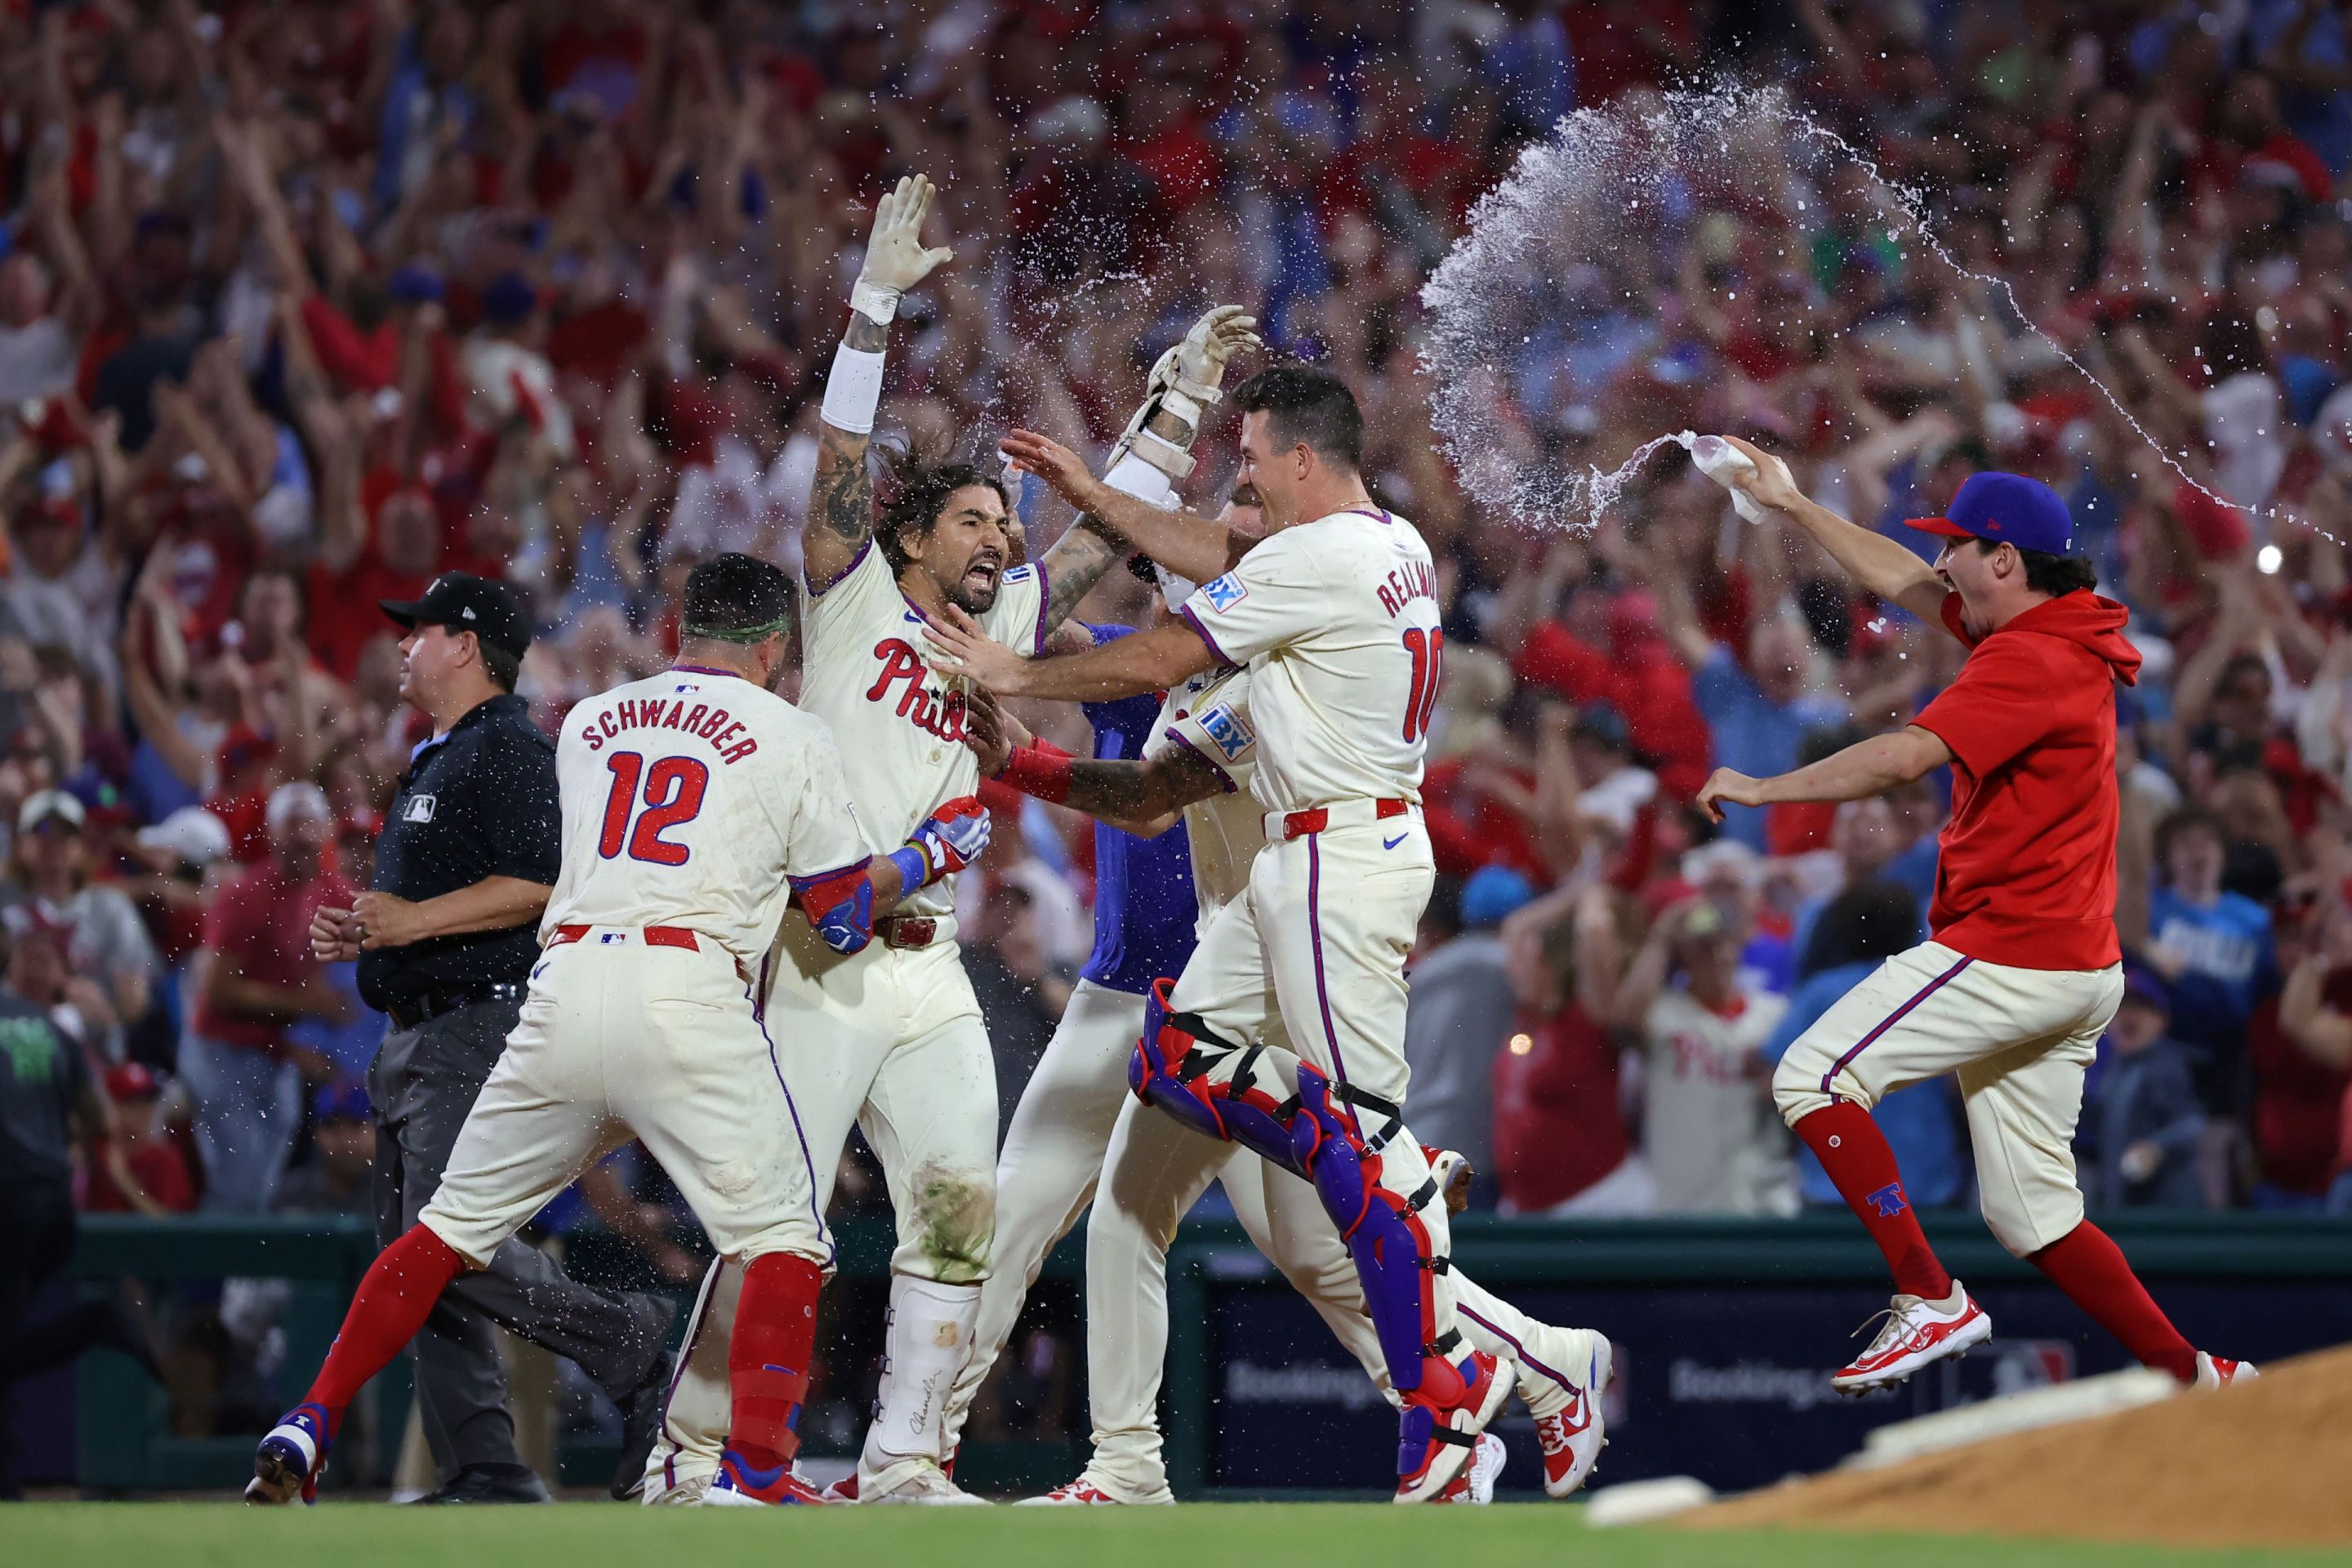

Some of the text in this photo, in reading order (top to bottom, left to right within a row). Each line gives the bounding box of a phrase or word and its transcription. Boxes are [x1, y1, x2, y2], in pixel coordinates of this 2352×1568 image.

[1376, 560, 1439, 619] REALMU
[1402, 626, 1444, 744] 10
[581, 698, 758, 765] SCHWARBER
[1200, 709, 1246, 758] IBX
[598, 751, 710, 866] 12
